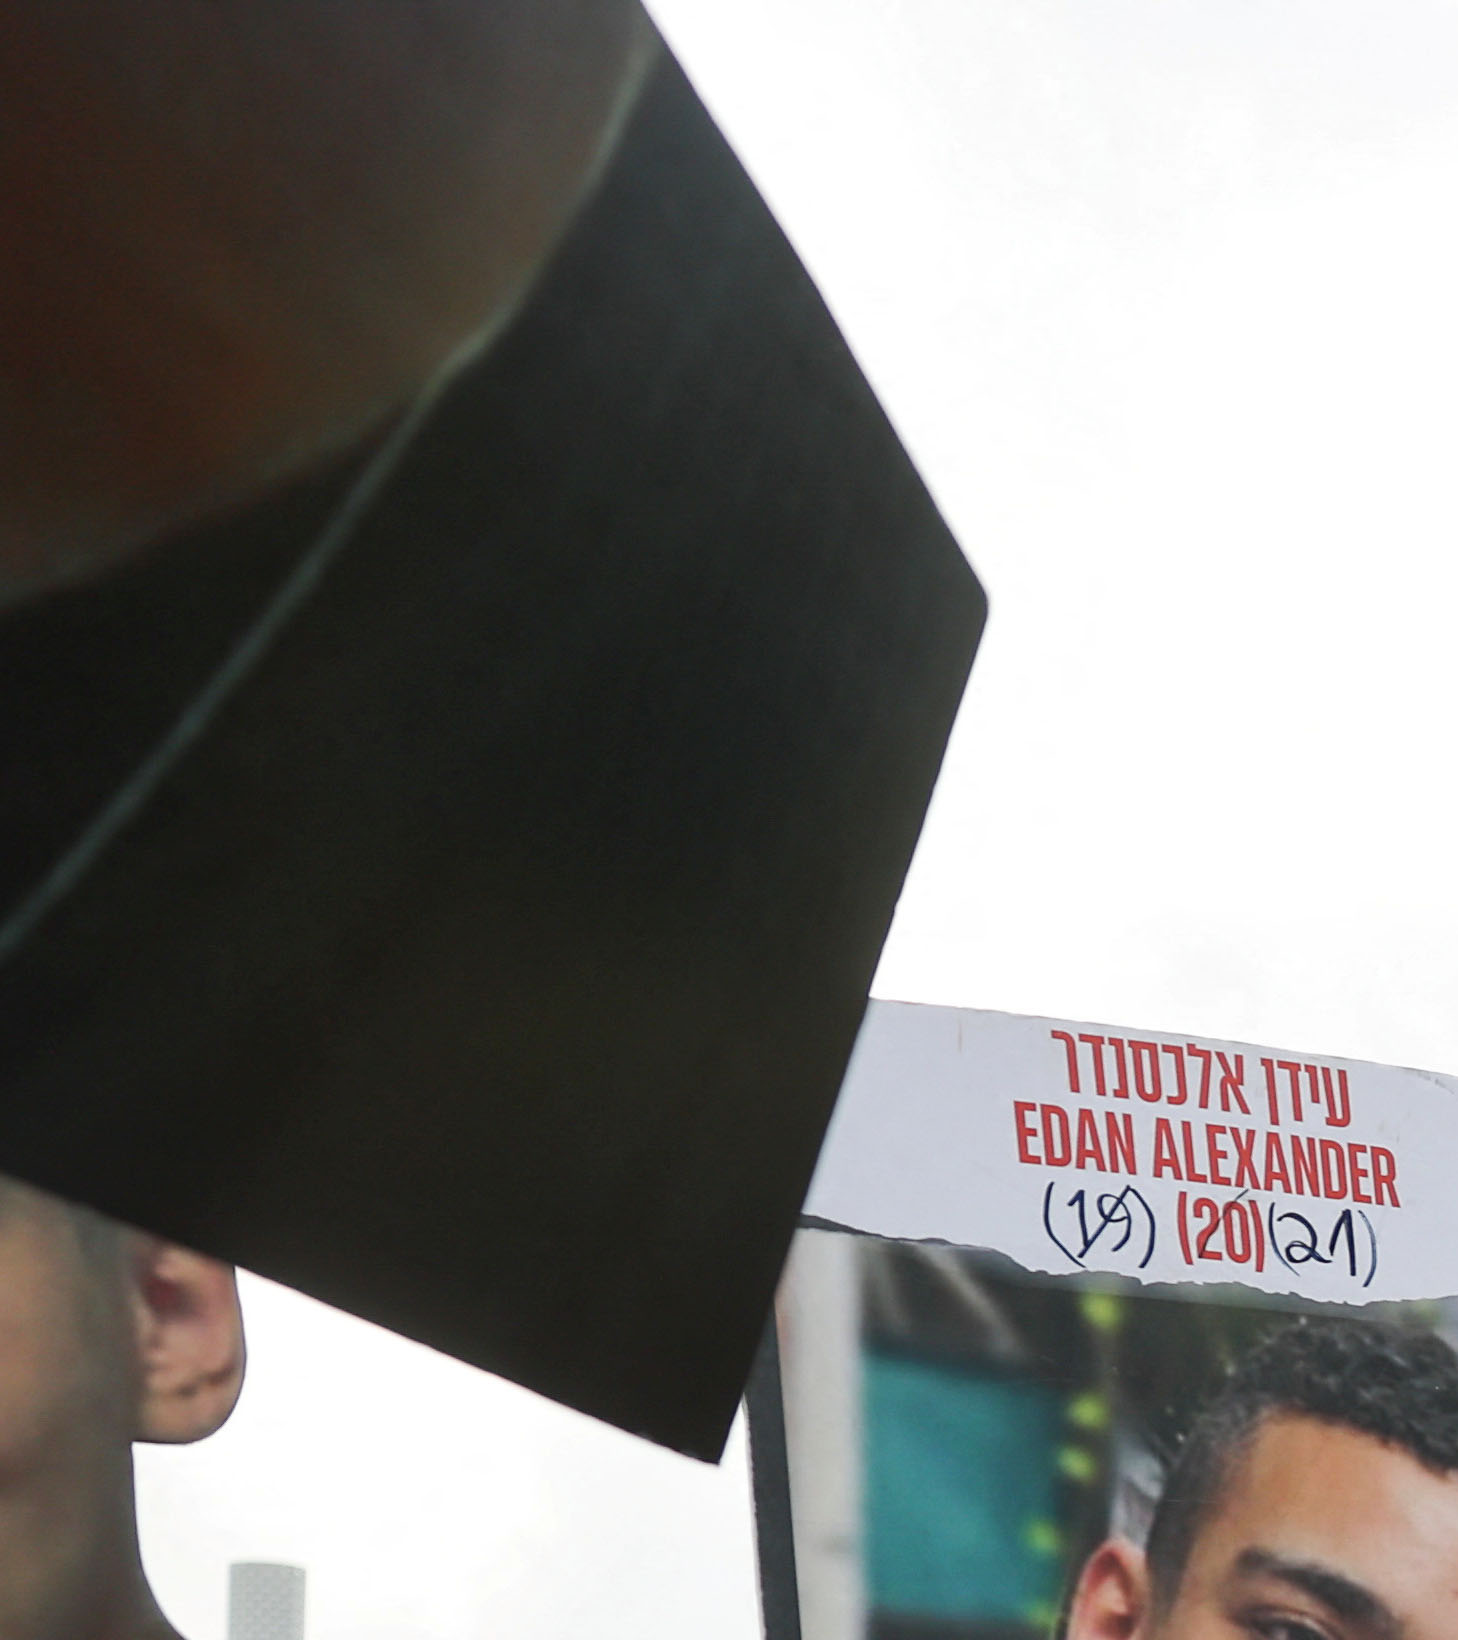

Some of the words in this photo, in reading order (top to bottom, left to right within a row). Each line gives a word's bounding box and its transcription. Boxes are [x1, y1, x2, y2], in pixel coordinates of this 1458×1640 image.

[1051, 1029, 1246, 1113] אלכסנדר
[1260, 1058, 1353, 1129] עידן
[1014, 1101, 1138, 1175] EDAN
[1152, 1119, 1401, 1208] ALEXANDER
